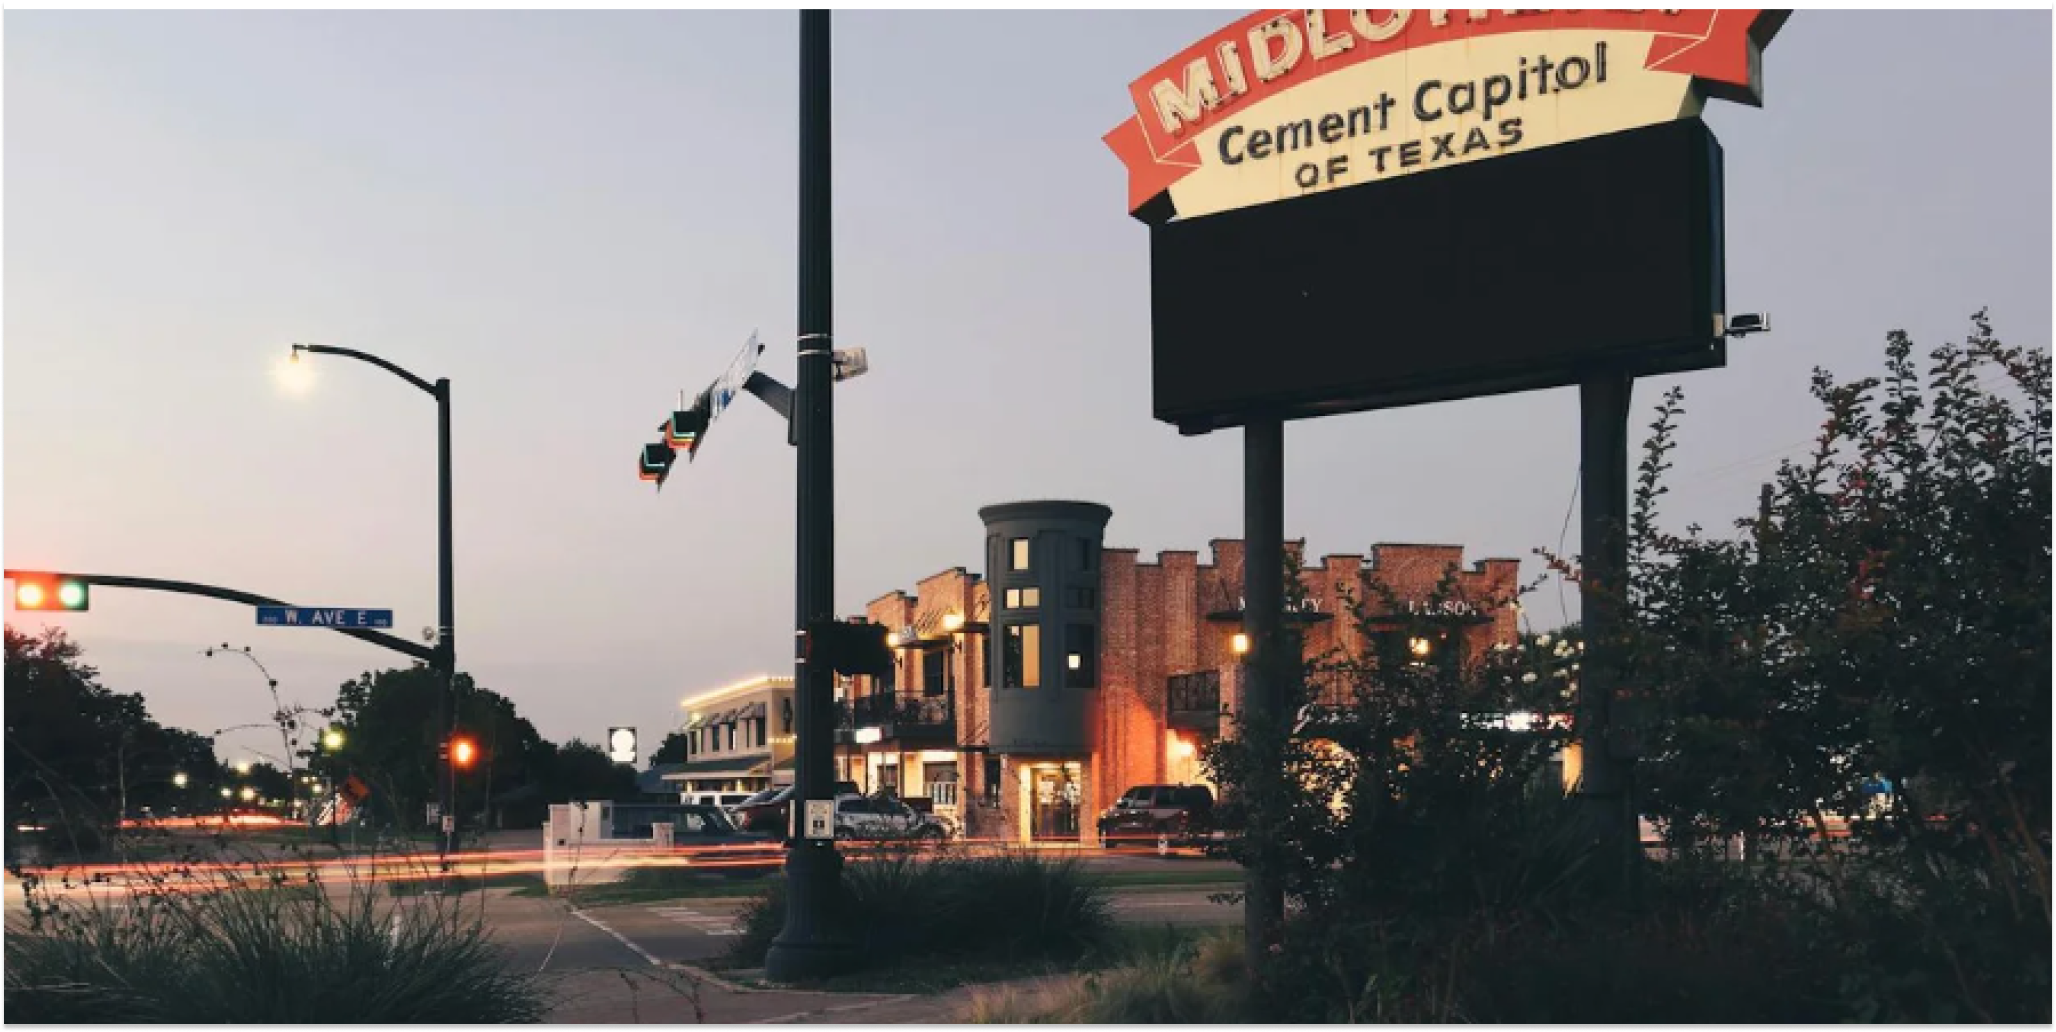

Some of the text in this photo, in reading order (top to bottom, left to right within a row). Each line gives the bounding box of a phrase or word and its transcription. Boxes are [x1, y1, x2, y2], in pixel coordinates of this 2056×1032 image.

[1149, 8, 1683, 133] MIDLO
[1219, 41, 1608, 165] Cement Capitol
[1295, 118, 1524, 189] OF TEXAS
[312, 609, 346, 625] AVE
[357, 610, 368, 625] E
[1409, 600, 1477, 616] LSON
